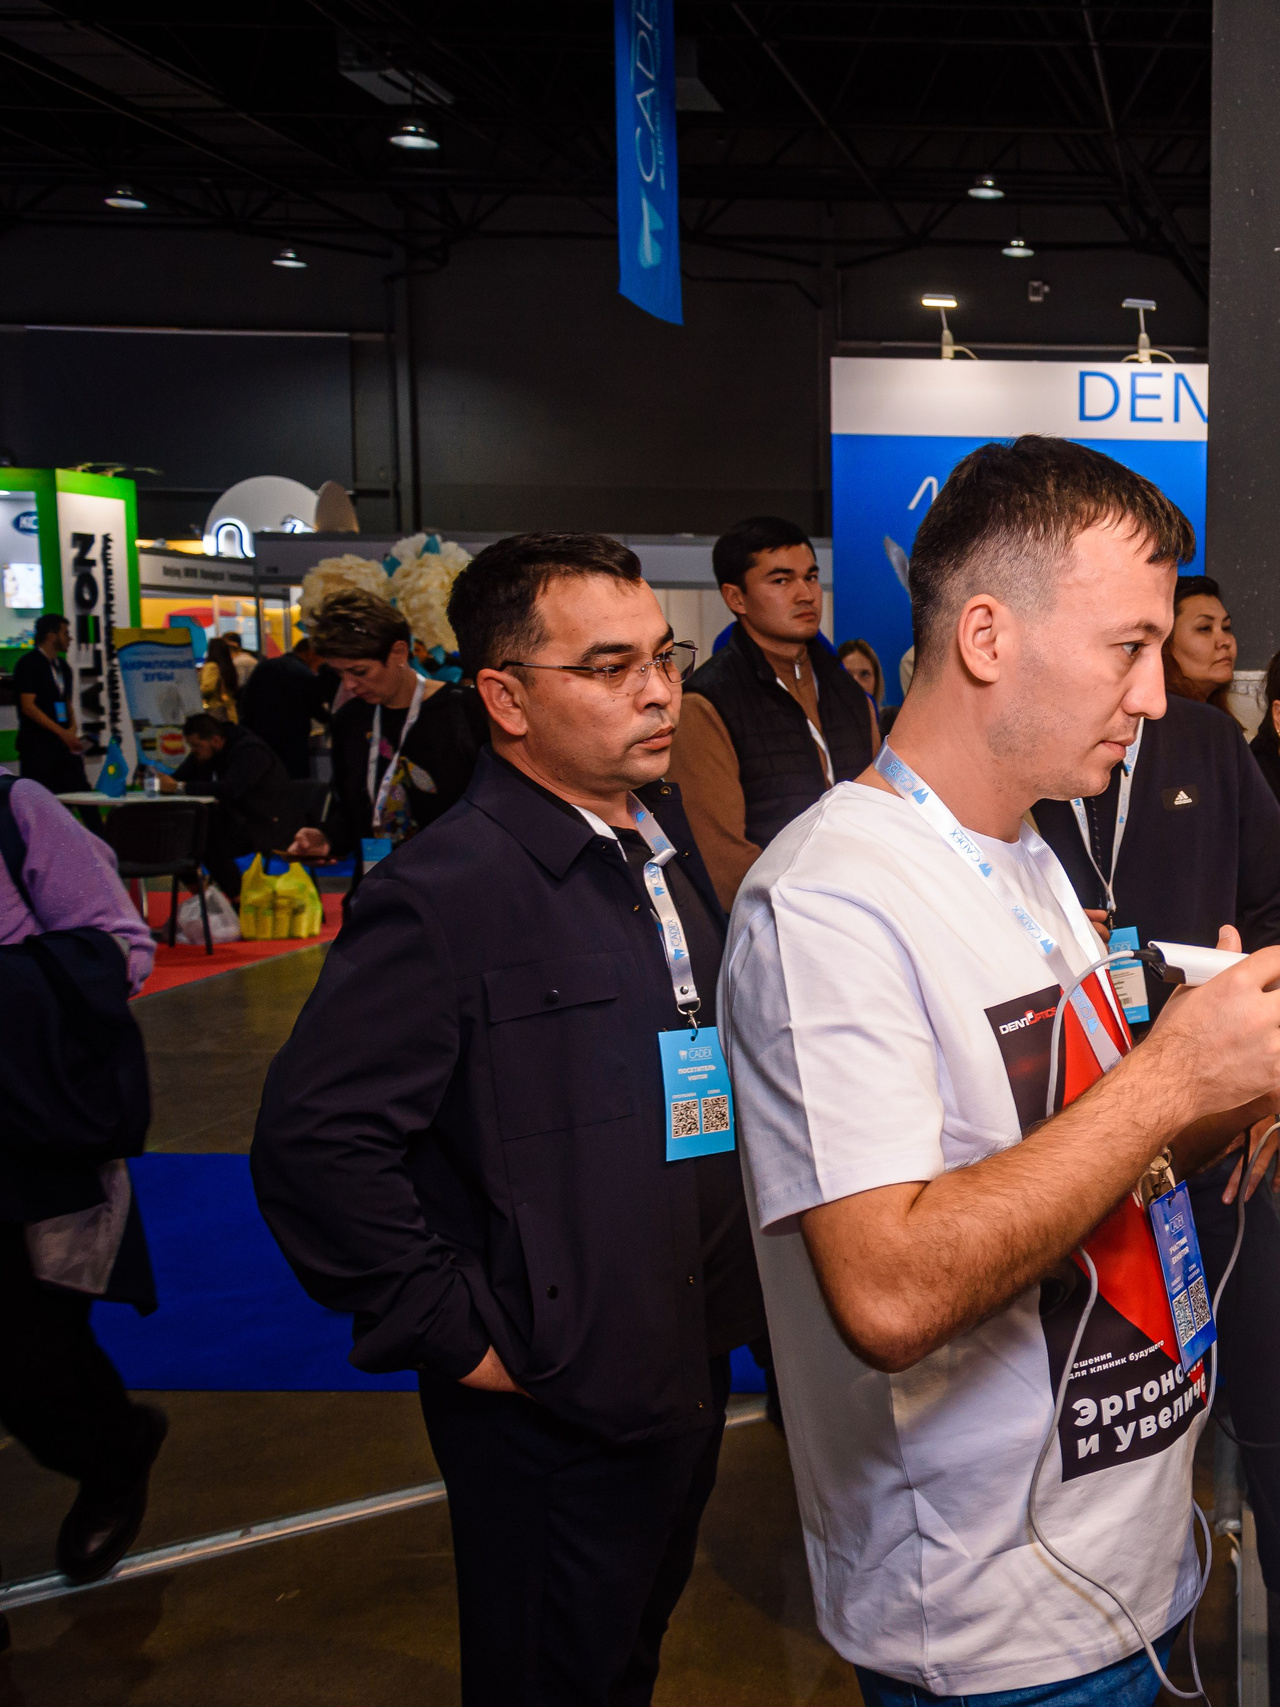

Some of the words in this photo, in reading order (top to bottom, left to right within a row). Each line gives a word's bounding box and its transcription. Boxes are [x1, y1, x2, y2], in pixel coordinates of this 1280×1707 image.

[949, 828, 981, 863] CADEX
[1011, 906, 1041, 940] CADEX
[1072, 1352, 1113, 1369] ешения
[1090, 1356, 1128, 1375] клиник
[1128, 1340, 1165, 1361] будущего
[1077, 1433, 1101, 1460] и
